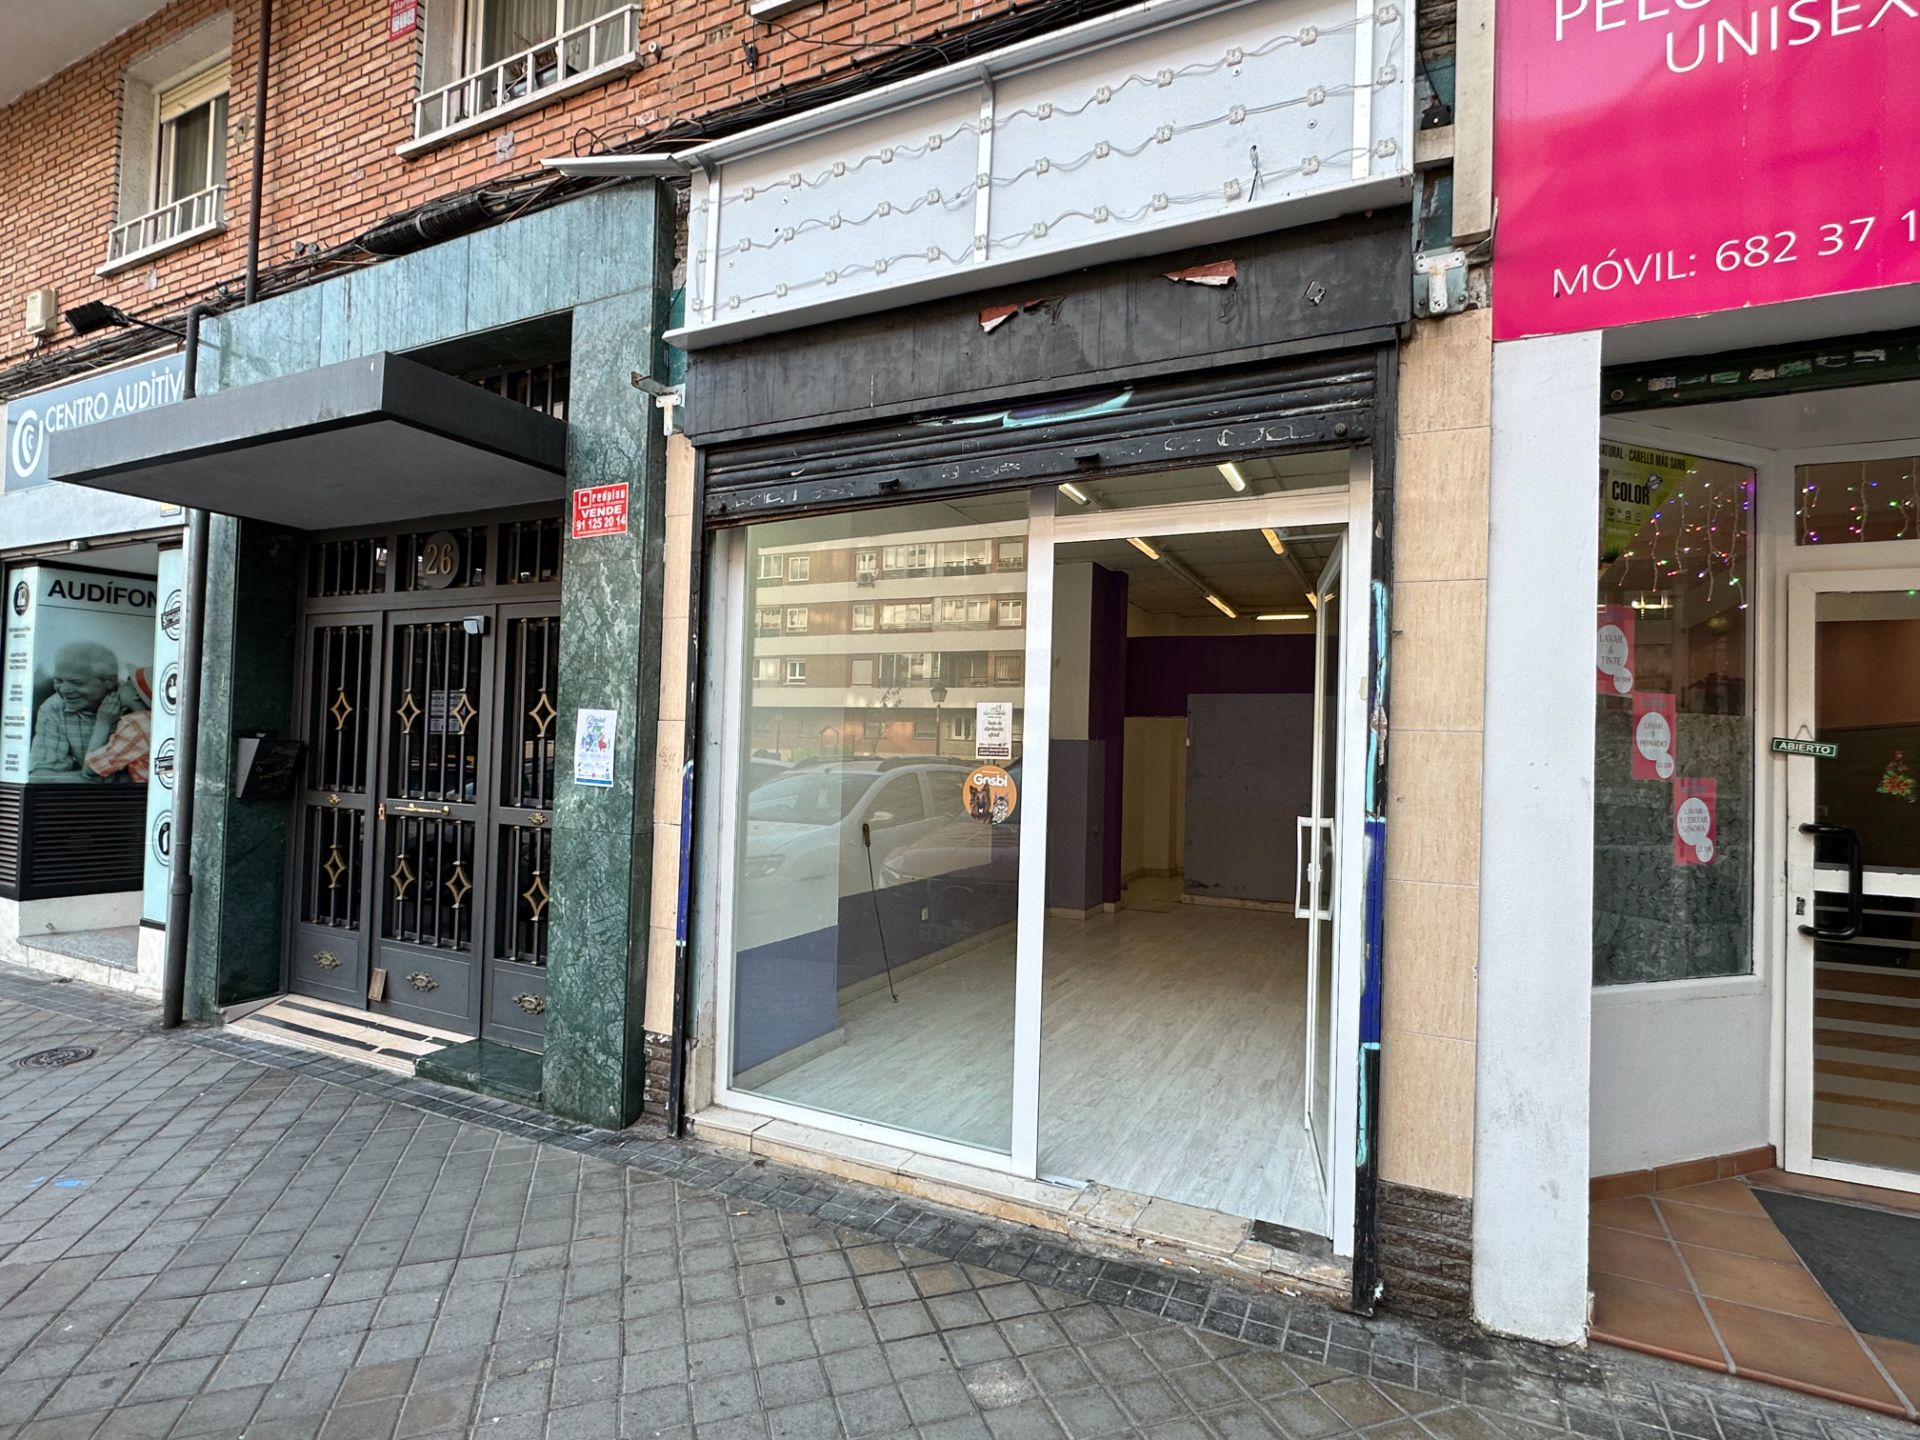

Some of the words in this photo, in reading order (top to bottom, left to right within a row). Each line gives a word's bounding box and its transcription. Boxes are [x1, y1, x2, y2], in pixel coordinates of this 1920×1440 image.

[1555, 0, 1714, 41] PEL
[1553, 248, 1696, 297] MÓVIL:
[1715, 231, 1798, 272] 682
[1818, 217, 1876, 256] 37
[45, 391, 108, 433] CENTRO
[1628, 448, 1654, 466] CABELLO
[591, 489, 626, 503] redpiso
[1612, 480, 1650, 505] COLOR
[581, 504, 622, 518] VENDE
[576, 519, 586, 531] 91
[588, 517, 602, 530] 125
[604, 515, 614, 528] 20
[616, 514, 626, 526] 14
[425, 543, 452, 574] 26
[1599, 634, 1623, 644] LAVAR
[1601, 656, 1621, 666] TINTE
[1778, 741, 1831, 754] ABIERTO
